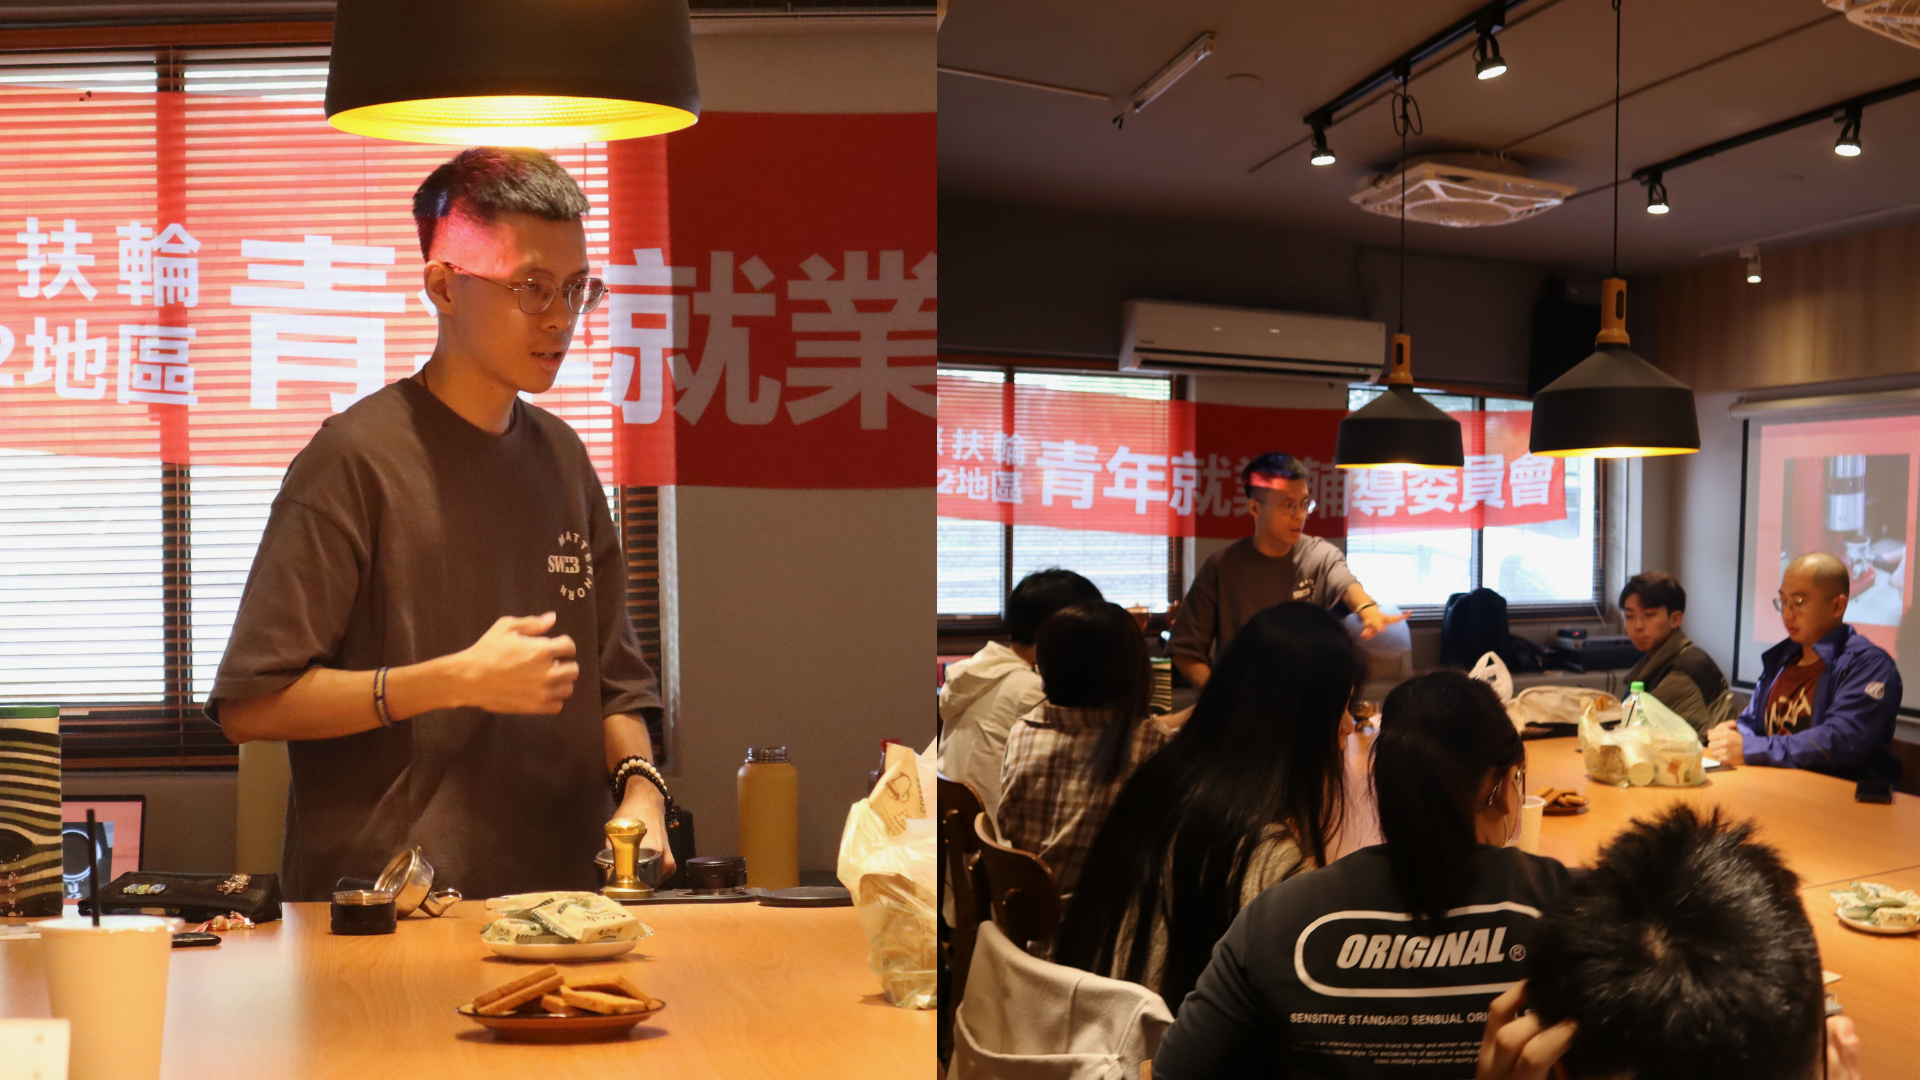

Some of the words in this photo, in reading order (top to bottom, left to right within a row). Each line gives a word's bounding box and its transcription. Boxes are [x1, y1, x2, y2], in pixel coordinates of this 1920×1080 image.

[15, 217, 200, 308] 扶輪
[231, 235, 938, 430] 青就業
[1336, 927, 1507, 969] ORIGINAL
[1290, 1012, 1346, 1025] SENSITIVE
[1348, 1014, 1409, 1026] STANDARD
[1411, 1012, 1465, 1026] SENSUAL
